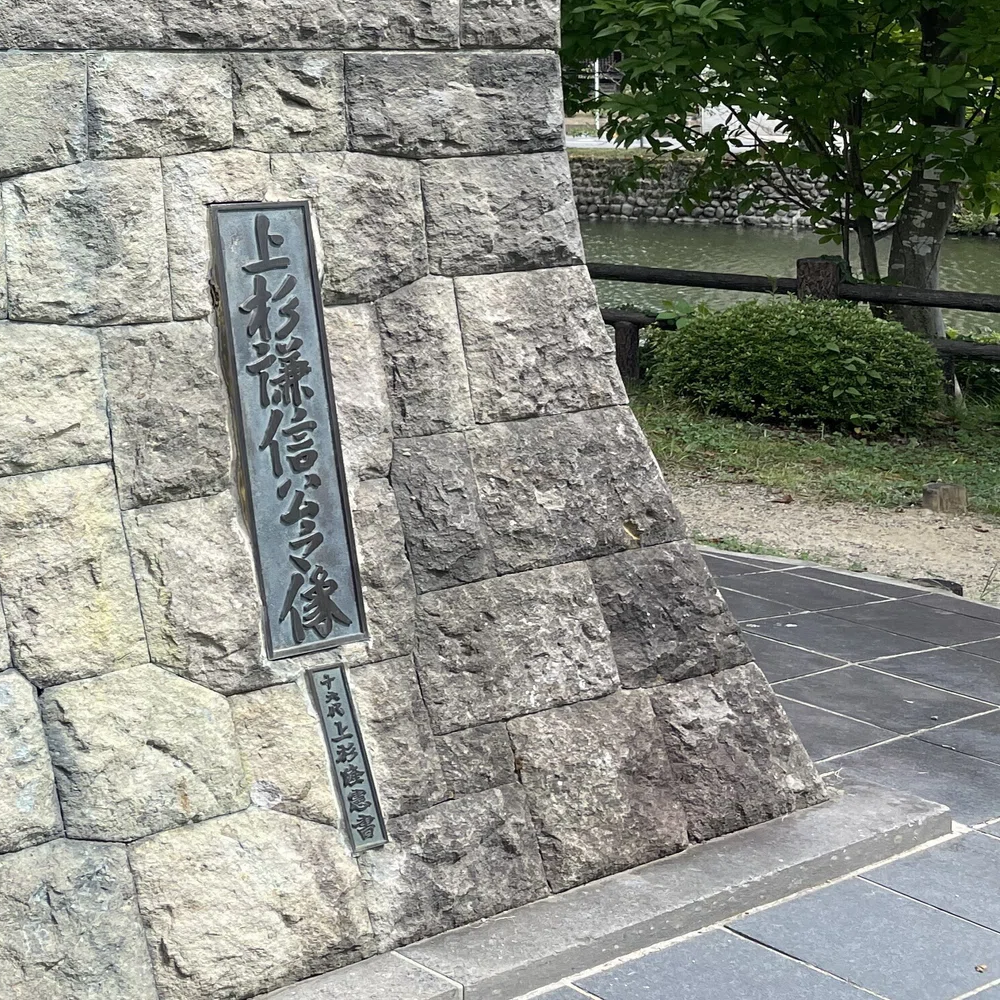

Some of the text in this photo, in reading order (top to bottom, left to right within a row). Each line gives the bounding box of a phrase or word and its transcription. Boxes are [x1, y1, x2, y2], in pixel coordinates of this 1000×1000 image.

[239, 213, 352, 645] 上杉謙信公之像
